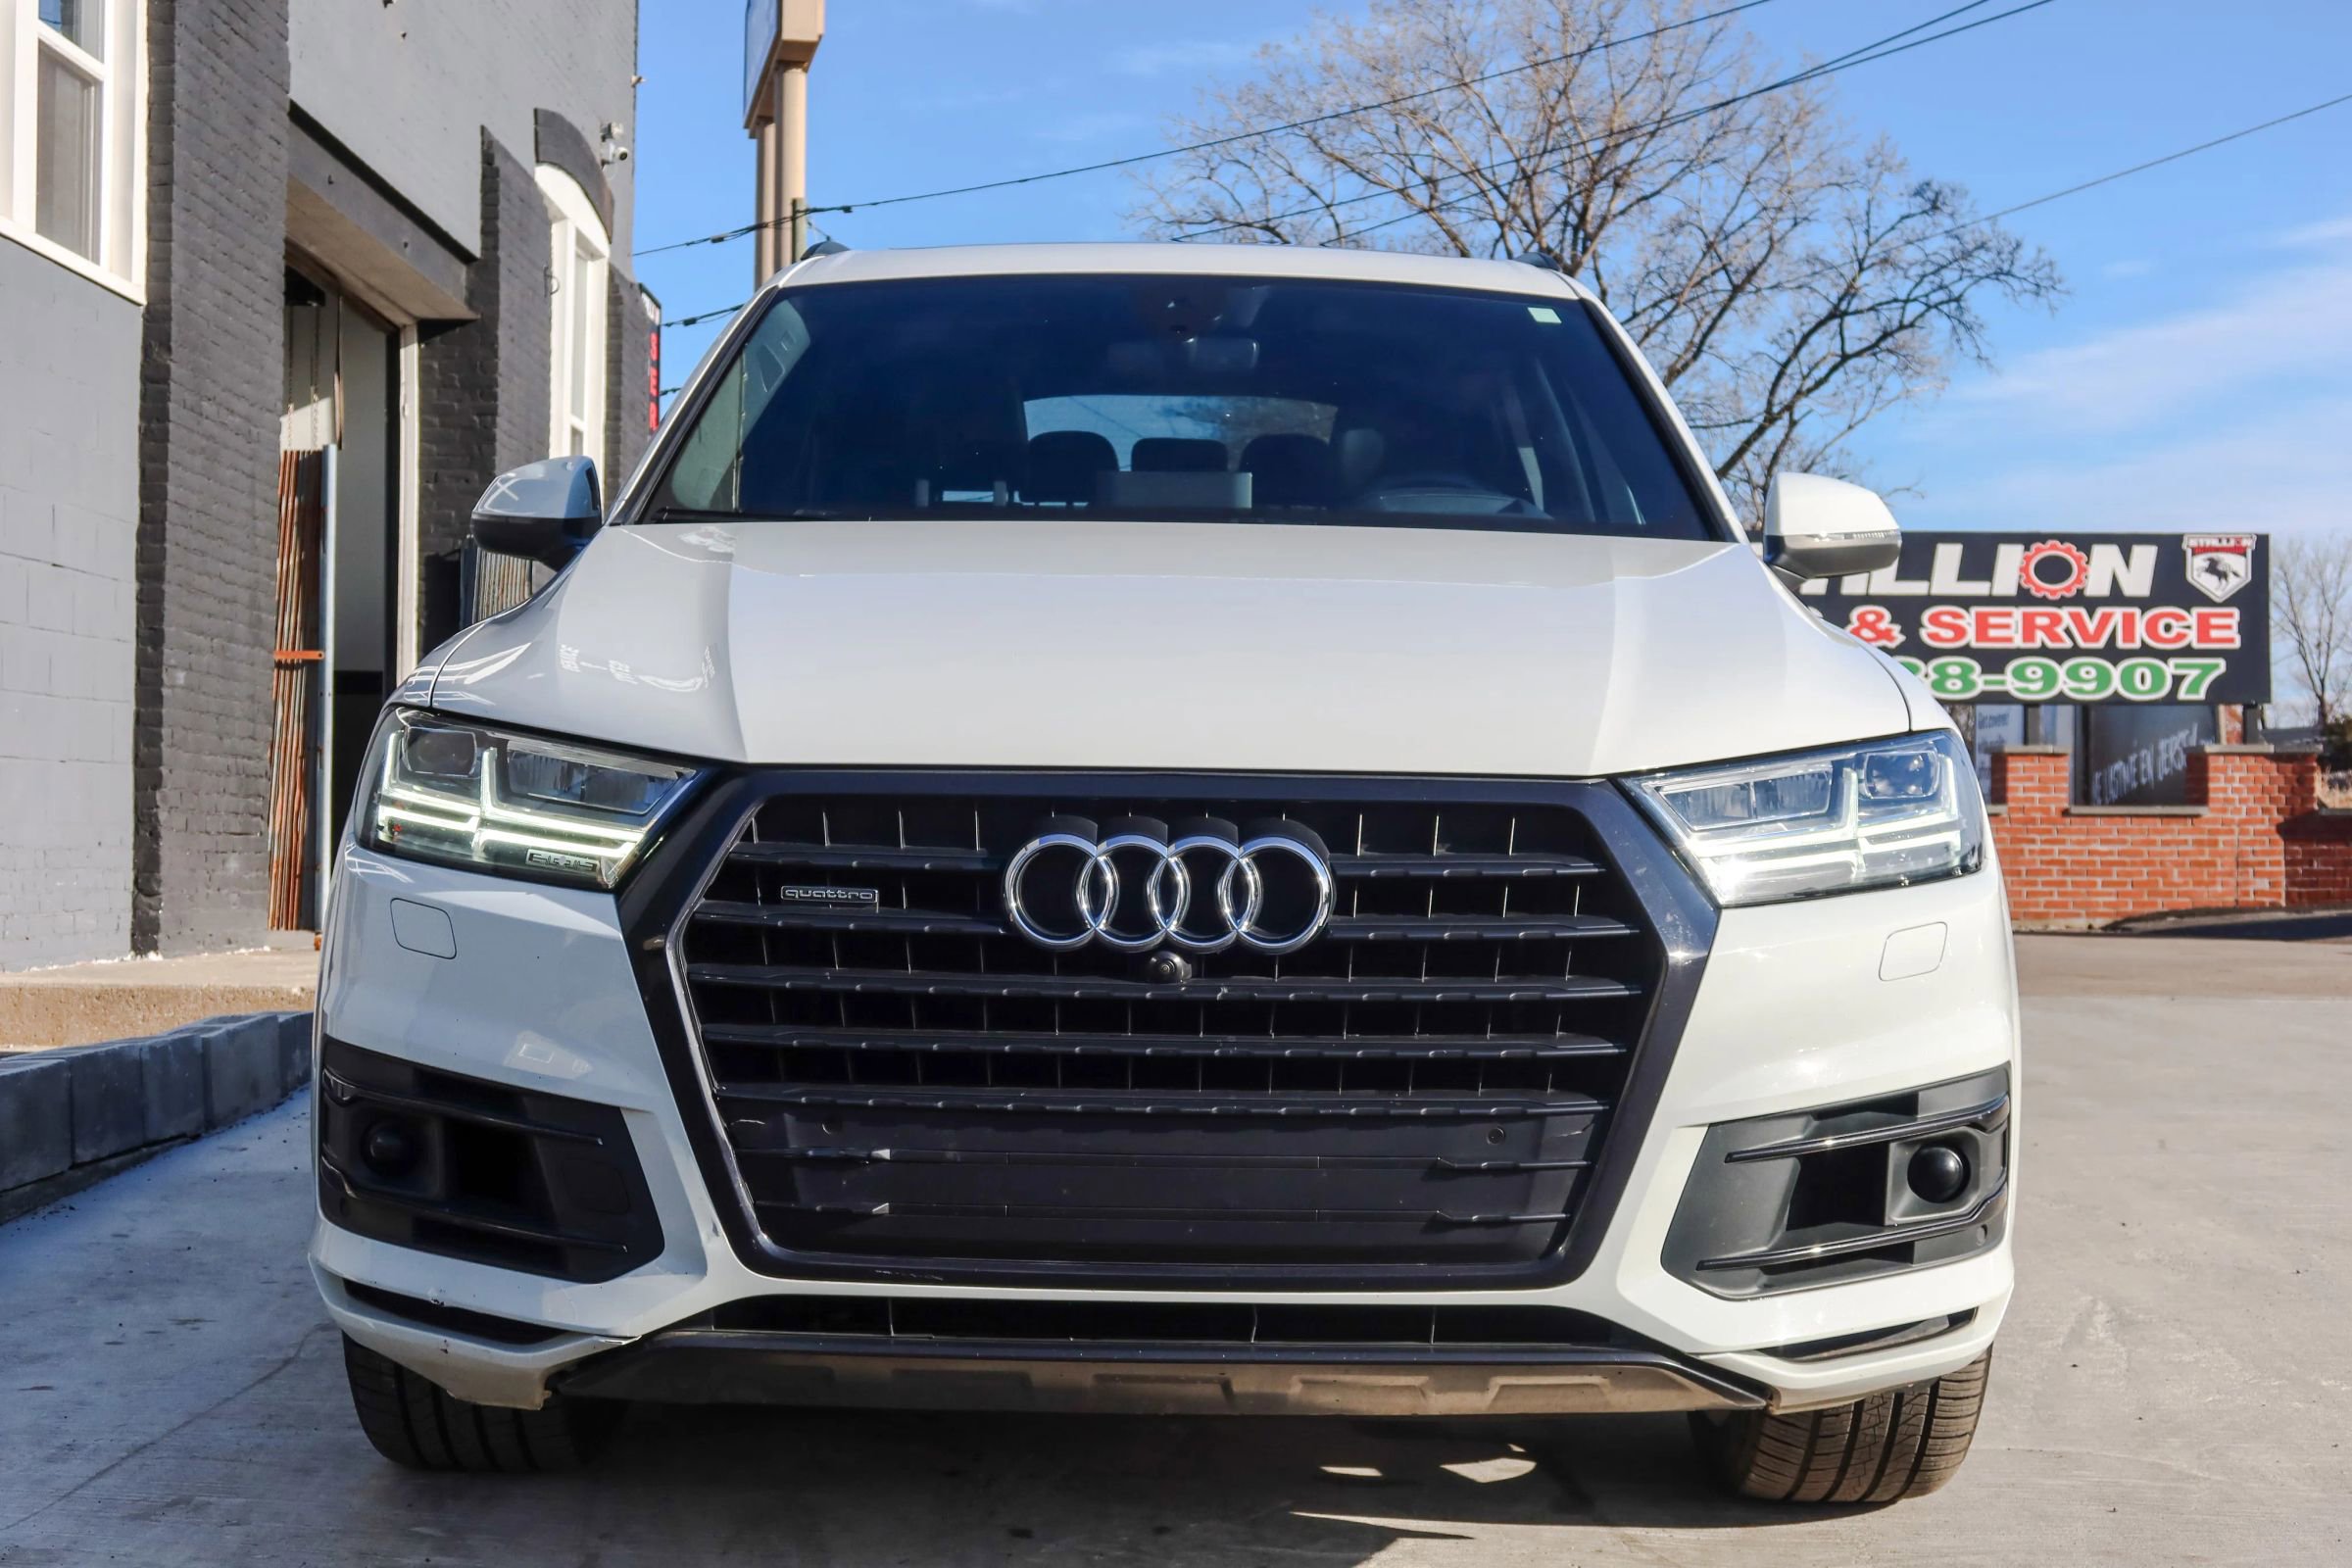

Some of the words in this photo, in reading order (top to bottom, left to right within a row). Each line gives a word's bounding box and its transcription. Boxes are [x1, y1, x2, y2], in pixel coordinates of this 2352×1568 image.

[1800, 540, 2157, 599] LLION
[1844, 606, 1906, 648] &
[1920, 607, 2241, 649] SERVICE
[785, 889, 873, 900] quattro
